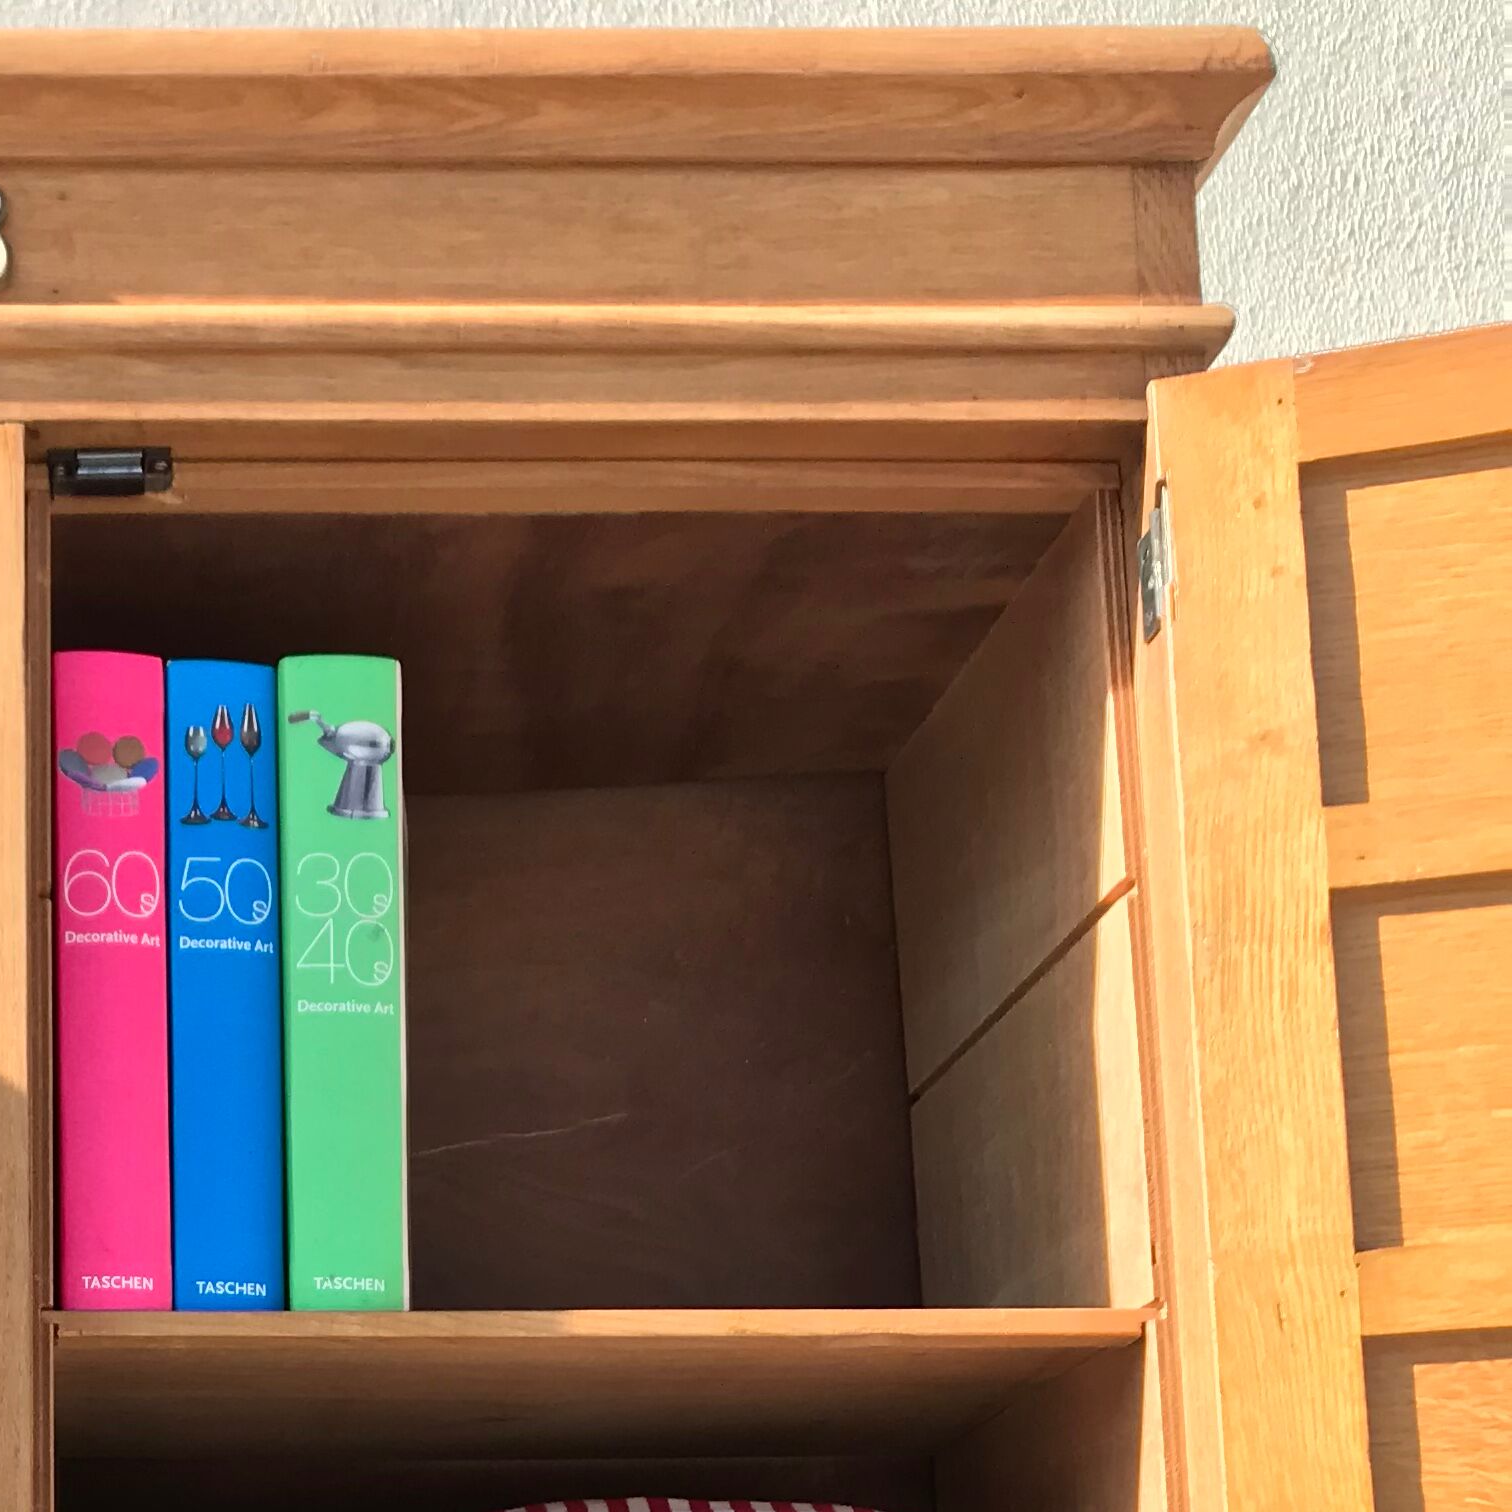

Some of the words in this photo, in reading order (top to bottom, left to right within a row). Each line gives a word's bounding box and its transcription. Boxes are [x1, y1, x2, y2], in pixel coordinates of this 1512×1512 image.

[65, 931, 139, 946] Decorative
[141, 931, 160, 947] Art
[179, 936, 251, 951] Decorative
[254, 940, 274, 954] Art
[297, 1000, 371, 1013] Decorative
[374, 1001, 394, 1015] Art
[81, 1275, 154, 1291] TASCHEN
[196, 1280, 267, 1297] TASCHEN
[313, 1276, 385, 1292] TASCHEN
